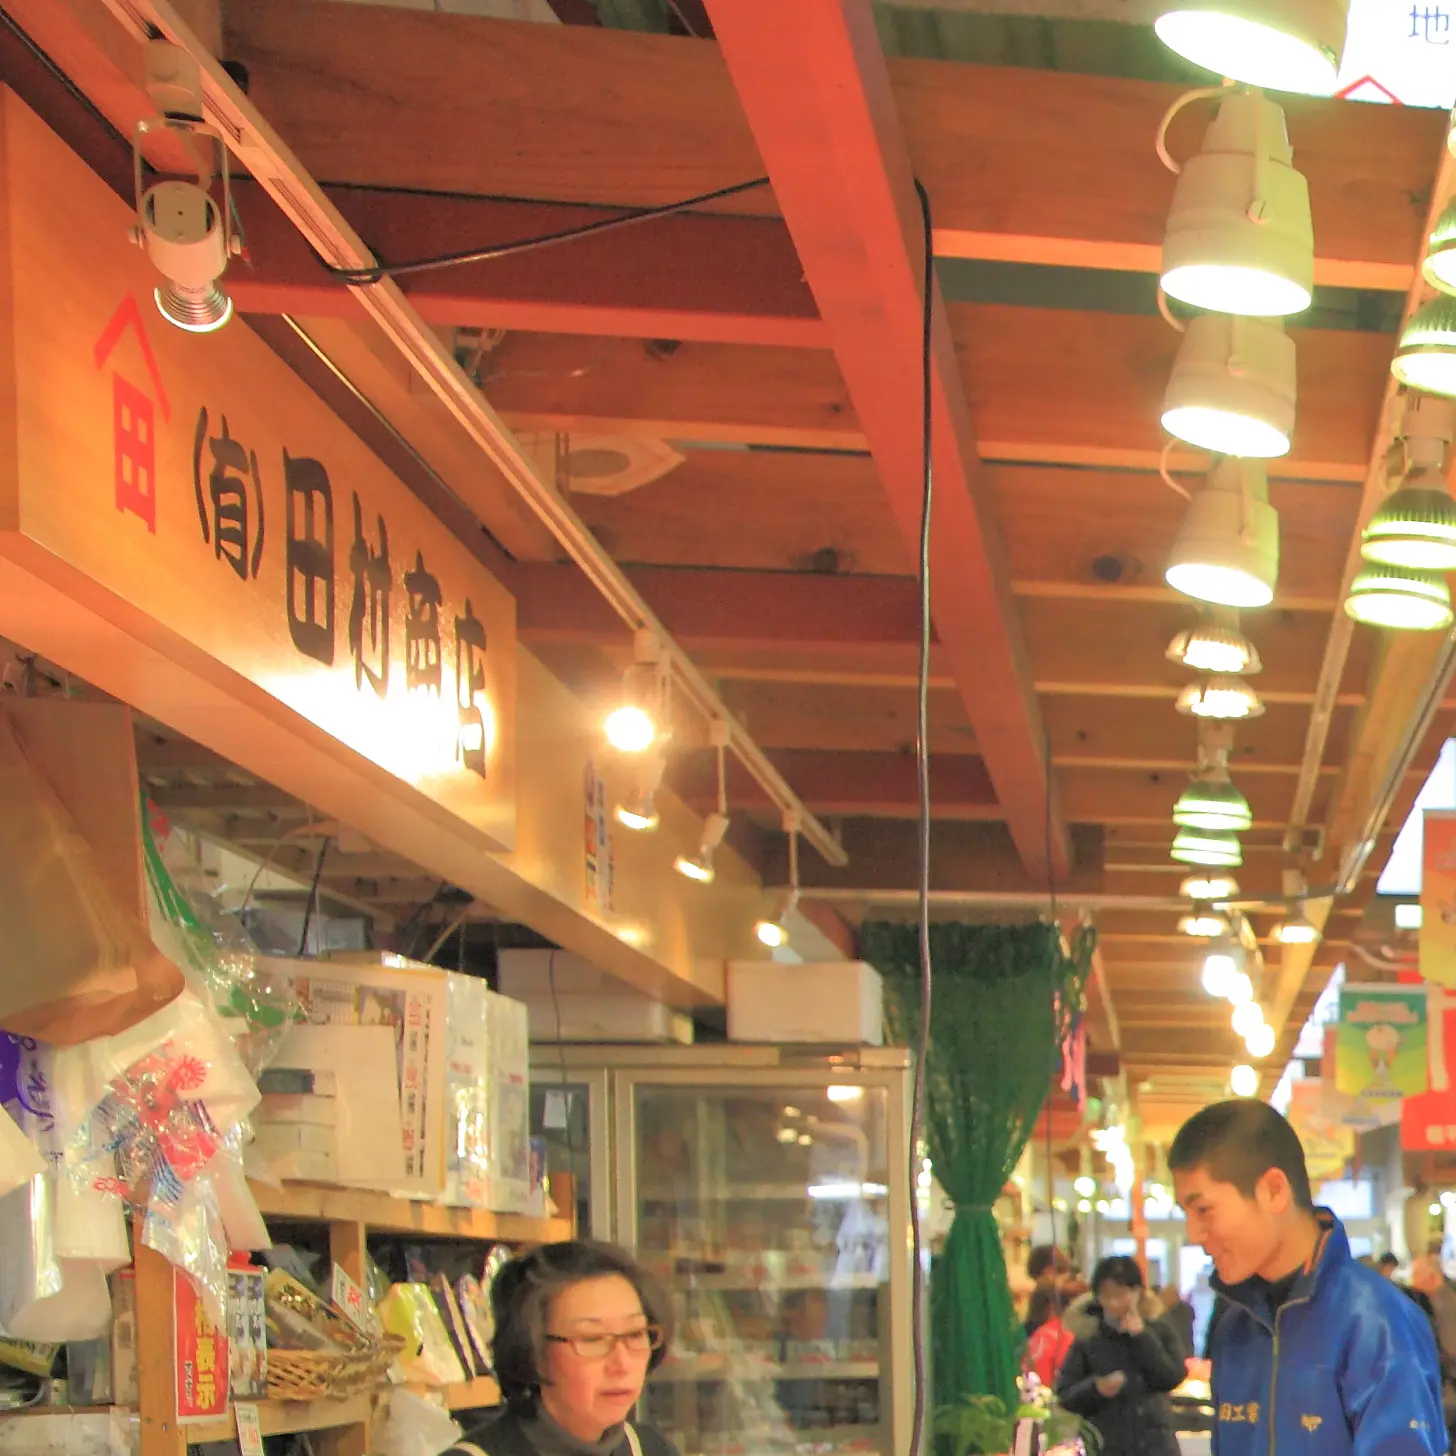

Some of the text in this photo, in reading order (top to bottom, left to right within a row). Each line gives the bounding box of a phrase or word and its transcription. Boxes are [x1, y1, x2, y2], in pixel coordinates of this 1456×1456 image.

[193, 405, 488, 780] (有)田村商店
